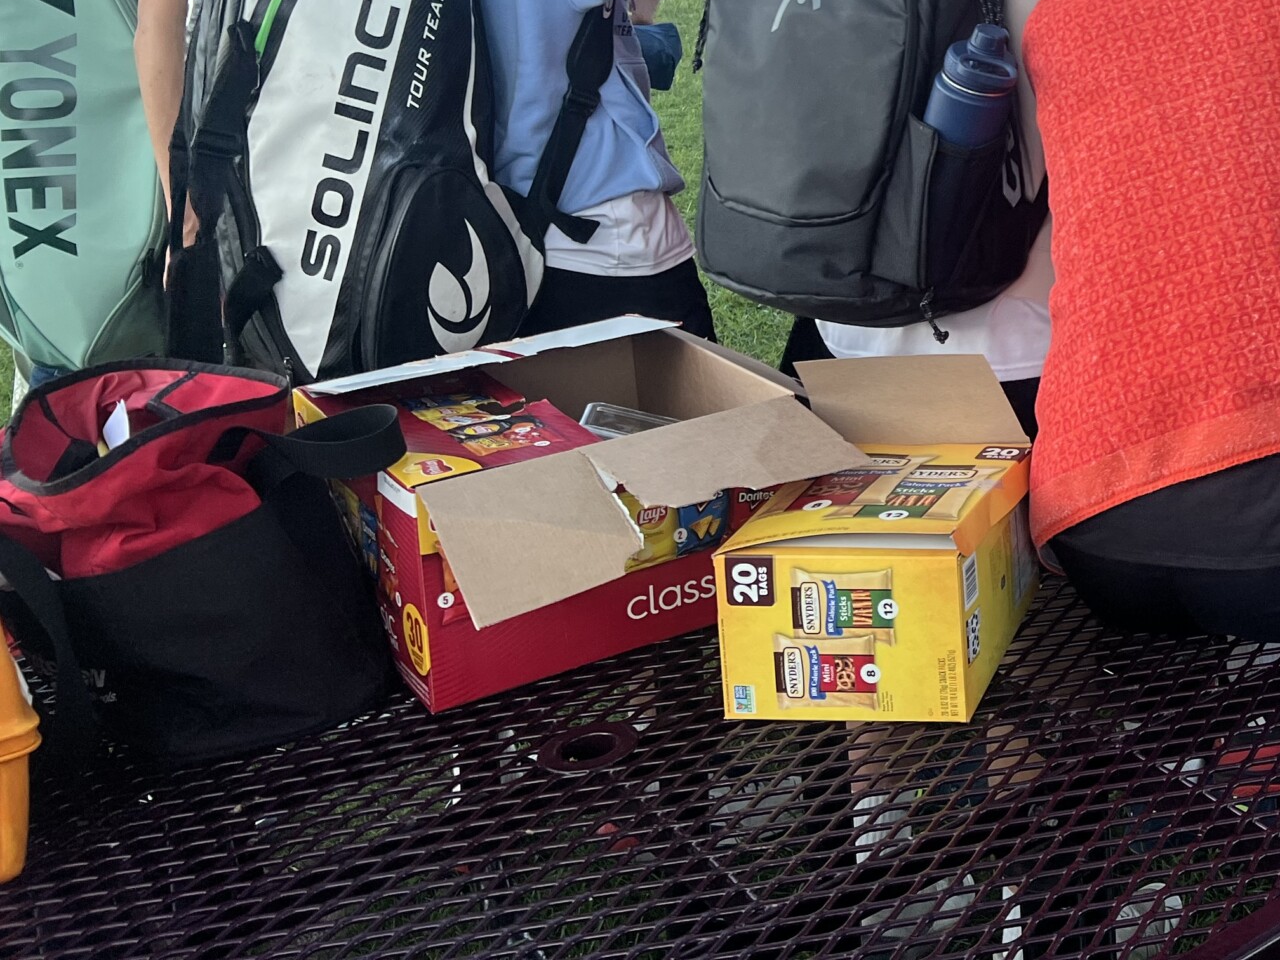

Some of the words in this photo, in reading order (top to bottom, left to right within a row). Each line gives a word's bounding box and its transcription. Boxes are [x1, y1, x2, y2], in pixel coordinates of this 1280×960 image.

[406, 48, 432, 110] TOUR
[0, 33, 79, 259] YONEX
[981, 446, 1020, 457] 20
[738, 490, 775, 503] Doritos
[678, 530, 684, 540] 2
[732, 563, 759, 603] 20
[758, 566, 769, 596] BAGS
[827, 583, 836, 599] Pack
[442, 596, 450, 606] 5
[803, 585, 816, 631] SNYDER'S
[827, 599, 836, 622] Calorie
[838, 595, 848, 621] Sticks
[883, 602, 894, 616] 12
[406, 612, 423, 654] 30
[809, 648, 818, 664] Pack
[937, 657, 946, 671] PACKS
[787, 651, 799, 695] SNYDER'S
[810, 664, 819, 687] Calorie
[821, 663, 831, 683] Mini
[939, 671, 947, 684] SNACK
[950, 709, 959, 717] NET
